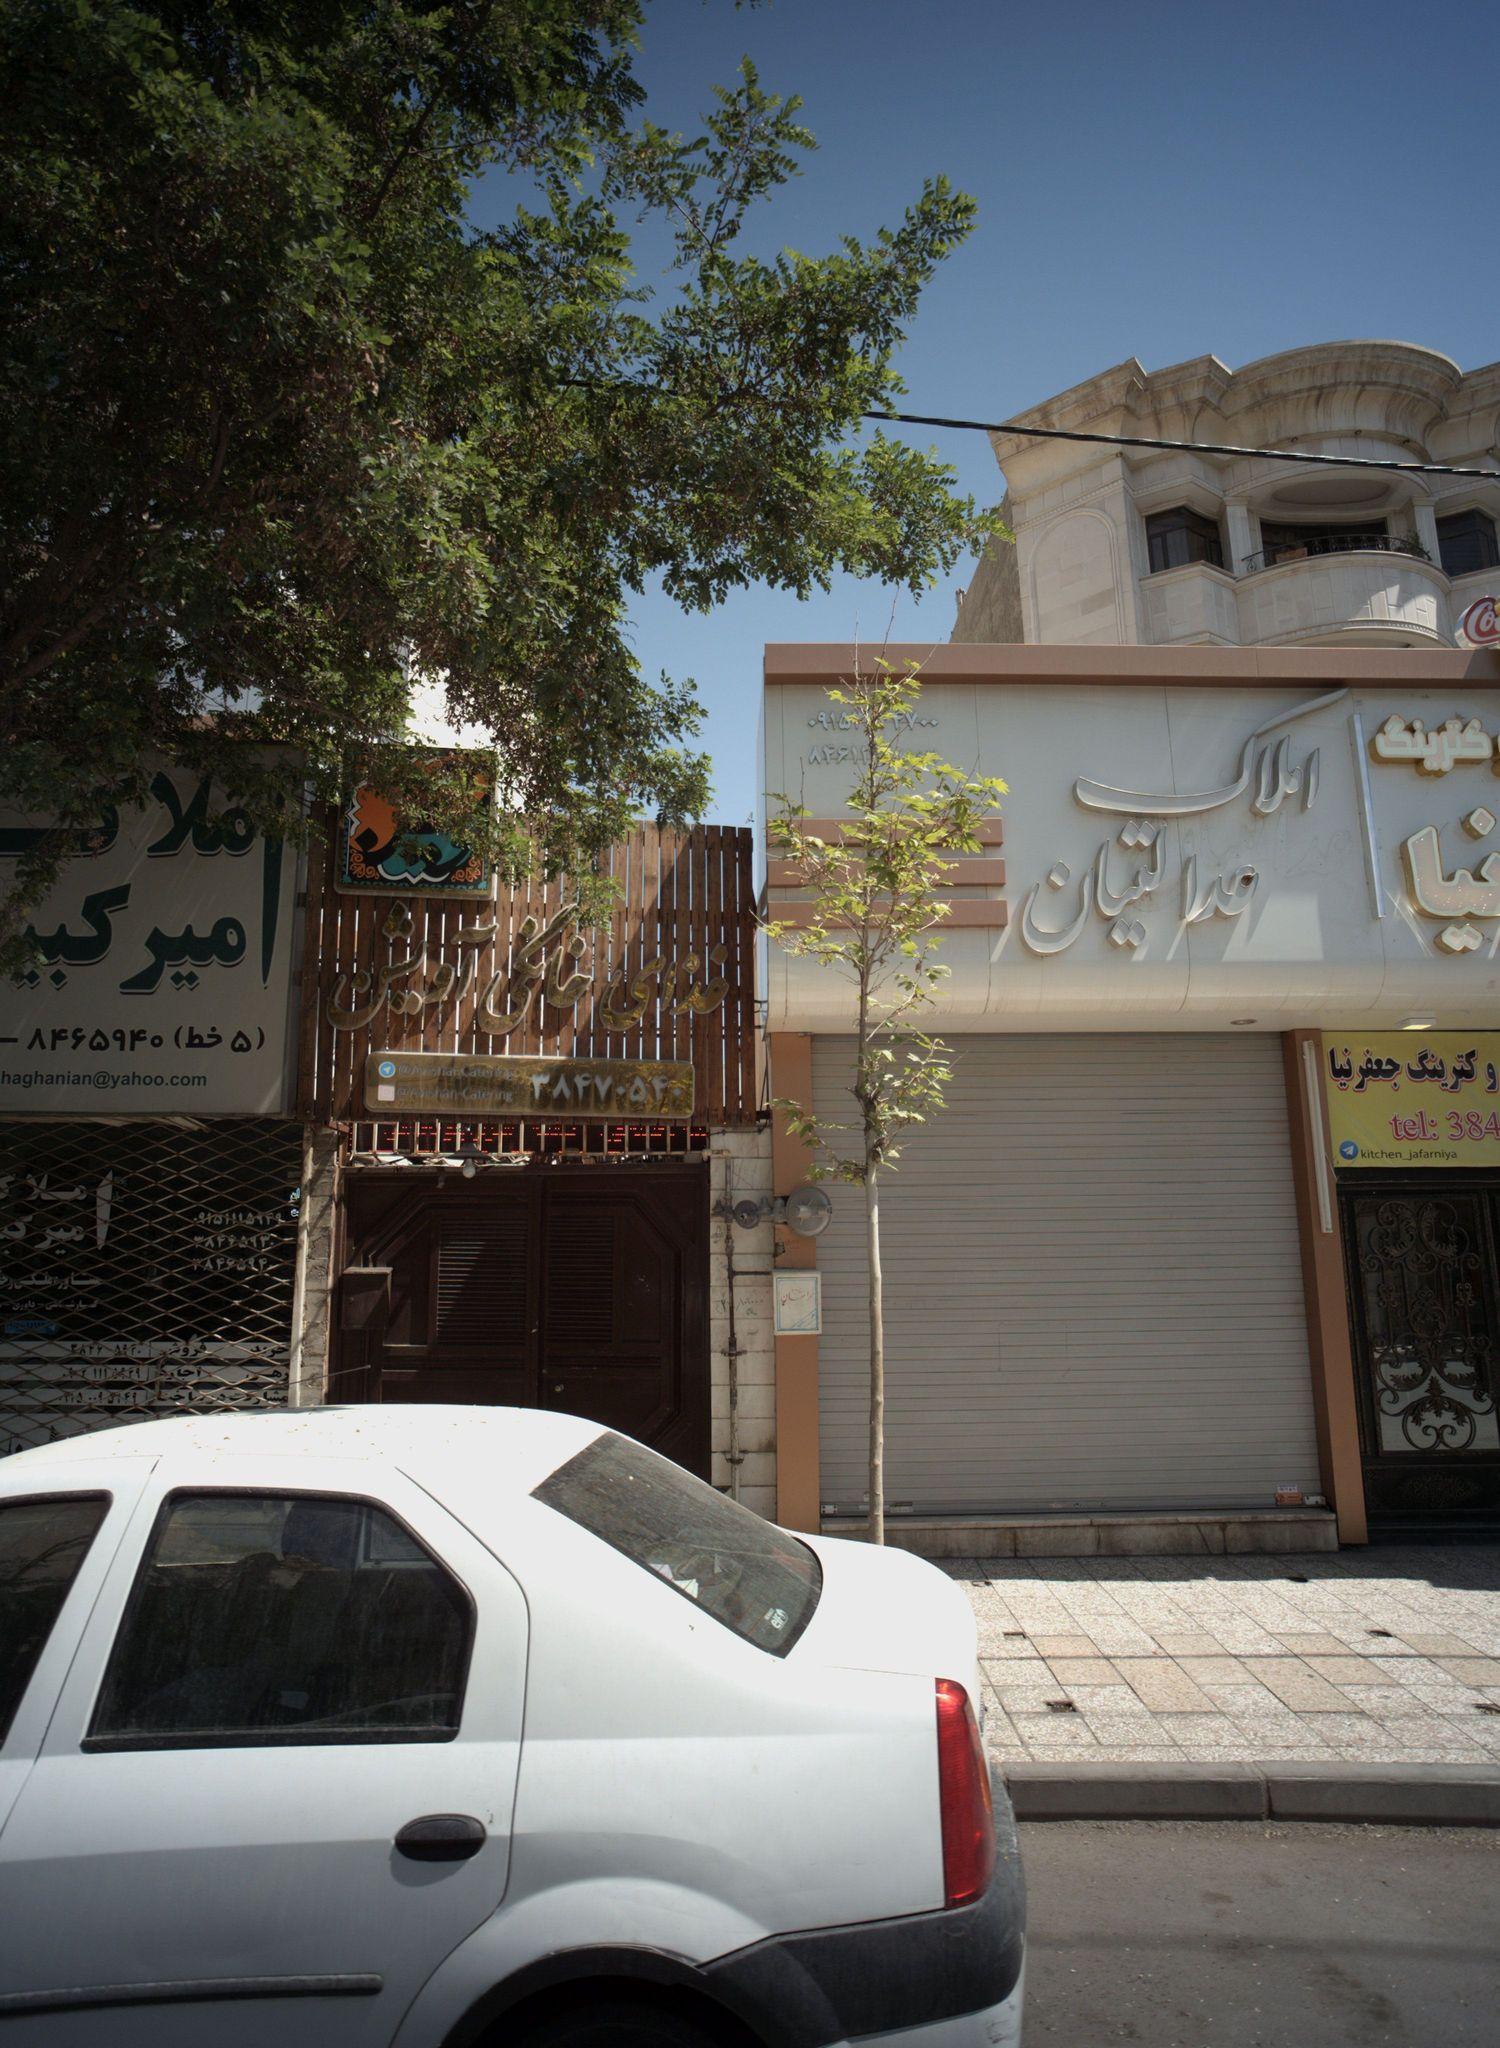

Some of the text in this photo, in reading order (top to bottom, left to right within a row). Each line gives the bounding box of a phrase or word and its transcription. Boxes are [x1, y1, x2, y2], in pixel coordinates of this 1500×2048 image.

[15, 882, 131, 990] کبی
[27, 1026, 164, 1052] ۸۴۶۵۹۴۰
[1407, 1049, 1477, 1090] کترینگ
[528, 1072, 682, 1102] ۳۸۴۷۰۵۴۰
[1390, 1110, 1439, 1140] tel:
[1360, 1149, 1458, 1161] kitchen_jafarniya
